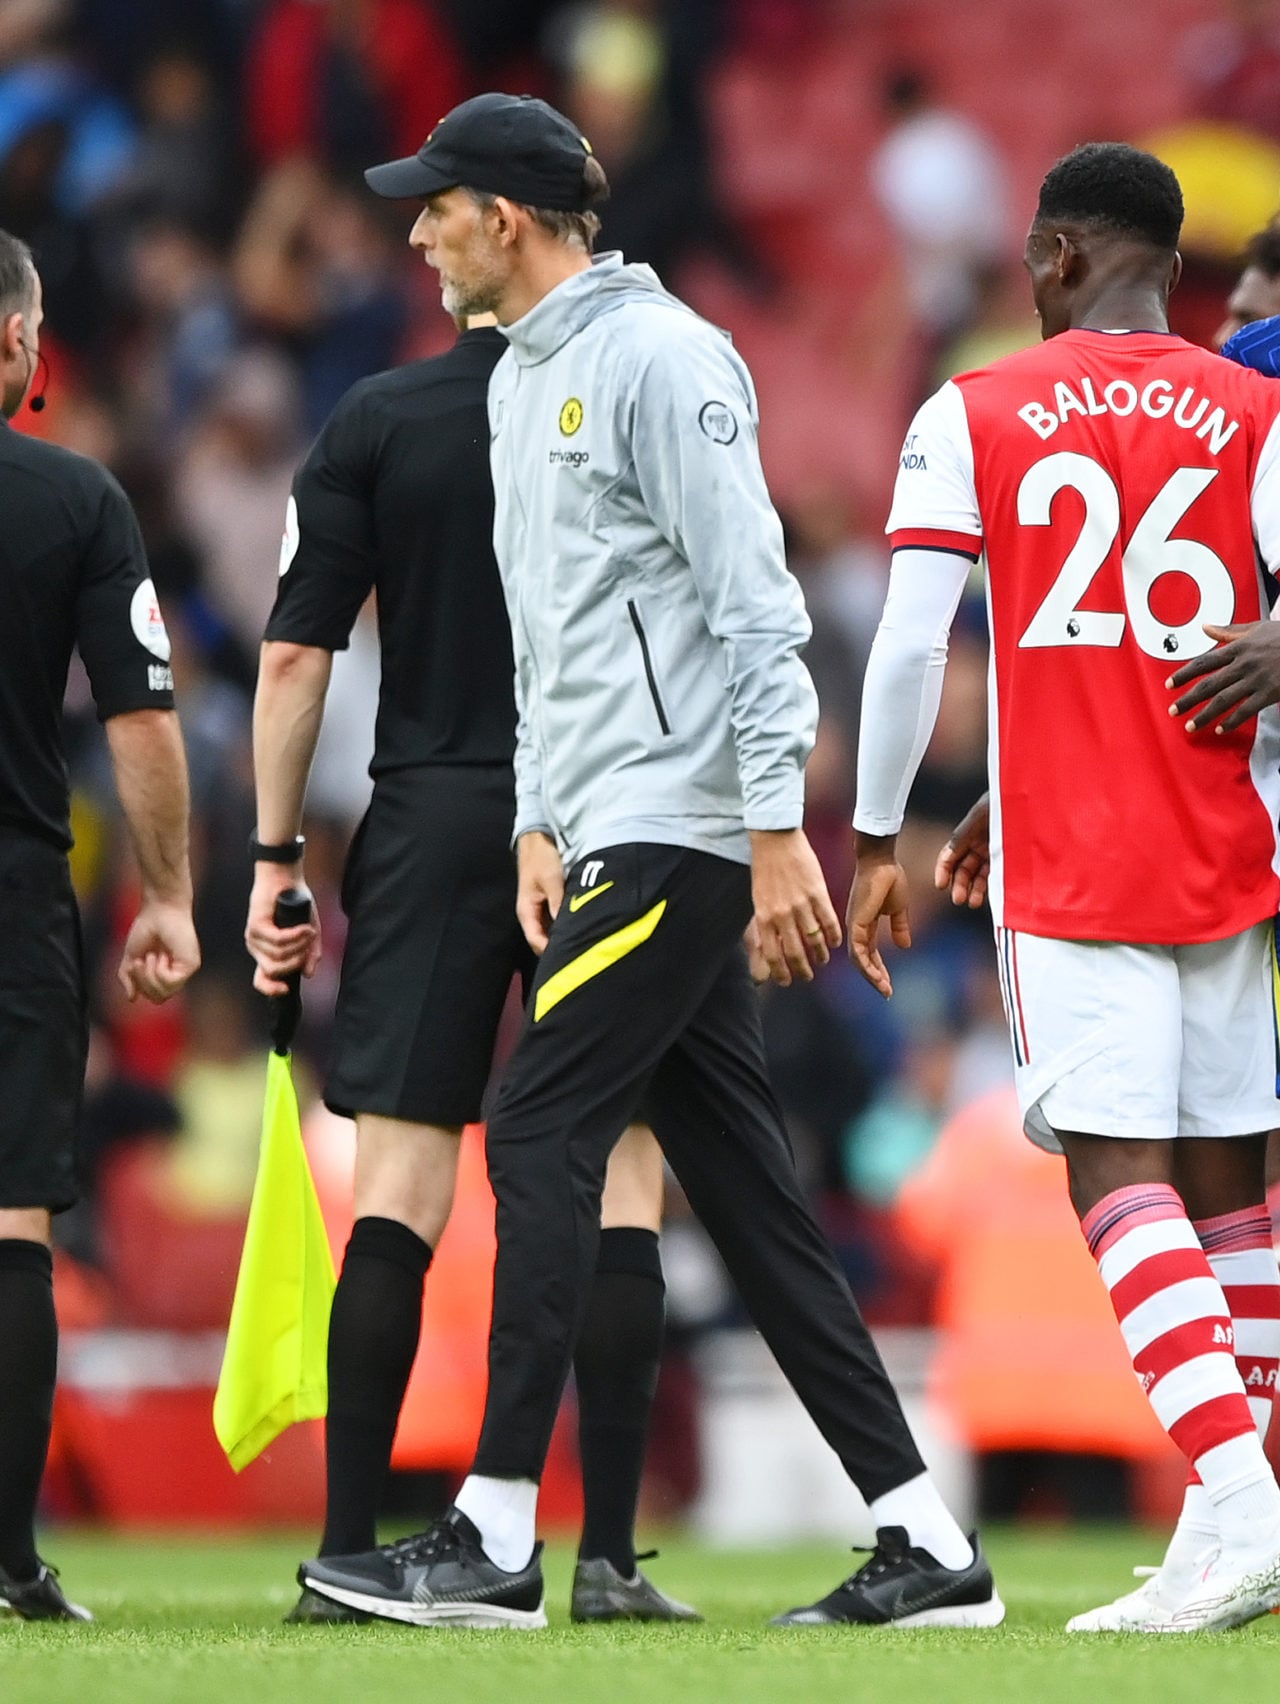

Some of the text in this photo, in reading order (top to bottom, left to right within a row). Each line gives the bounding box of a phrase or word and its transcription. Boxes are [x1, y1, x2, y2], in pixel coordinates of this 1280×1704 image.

[1017, 377, 1240, 456] BALOGUN
[549, 448, 590, 469] trivago
[900, 453, 927, 470] NDA
[1017, 451, 1236, 662] 26
